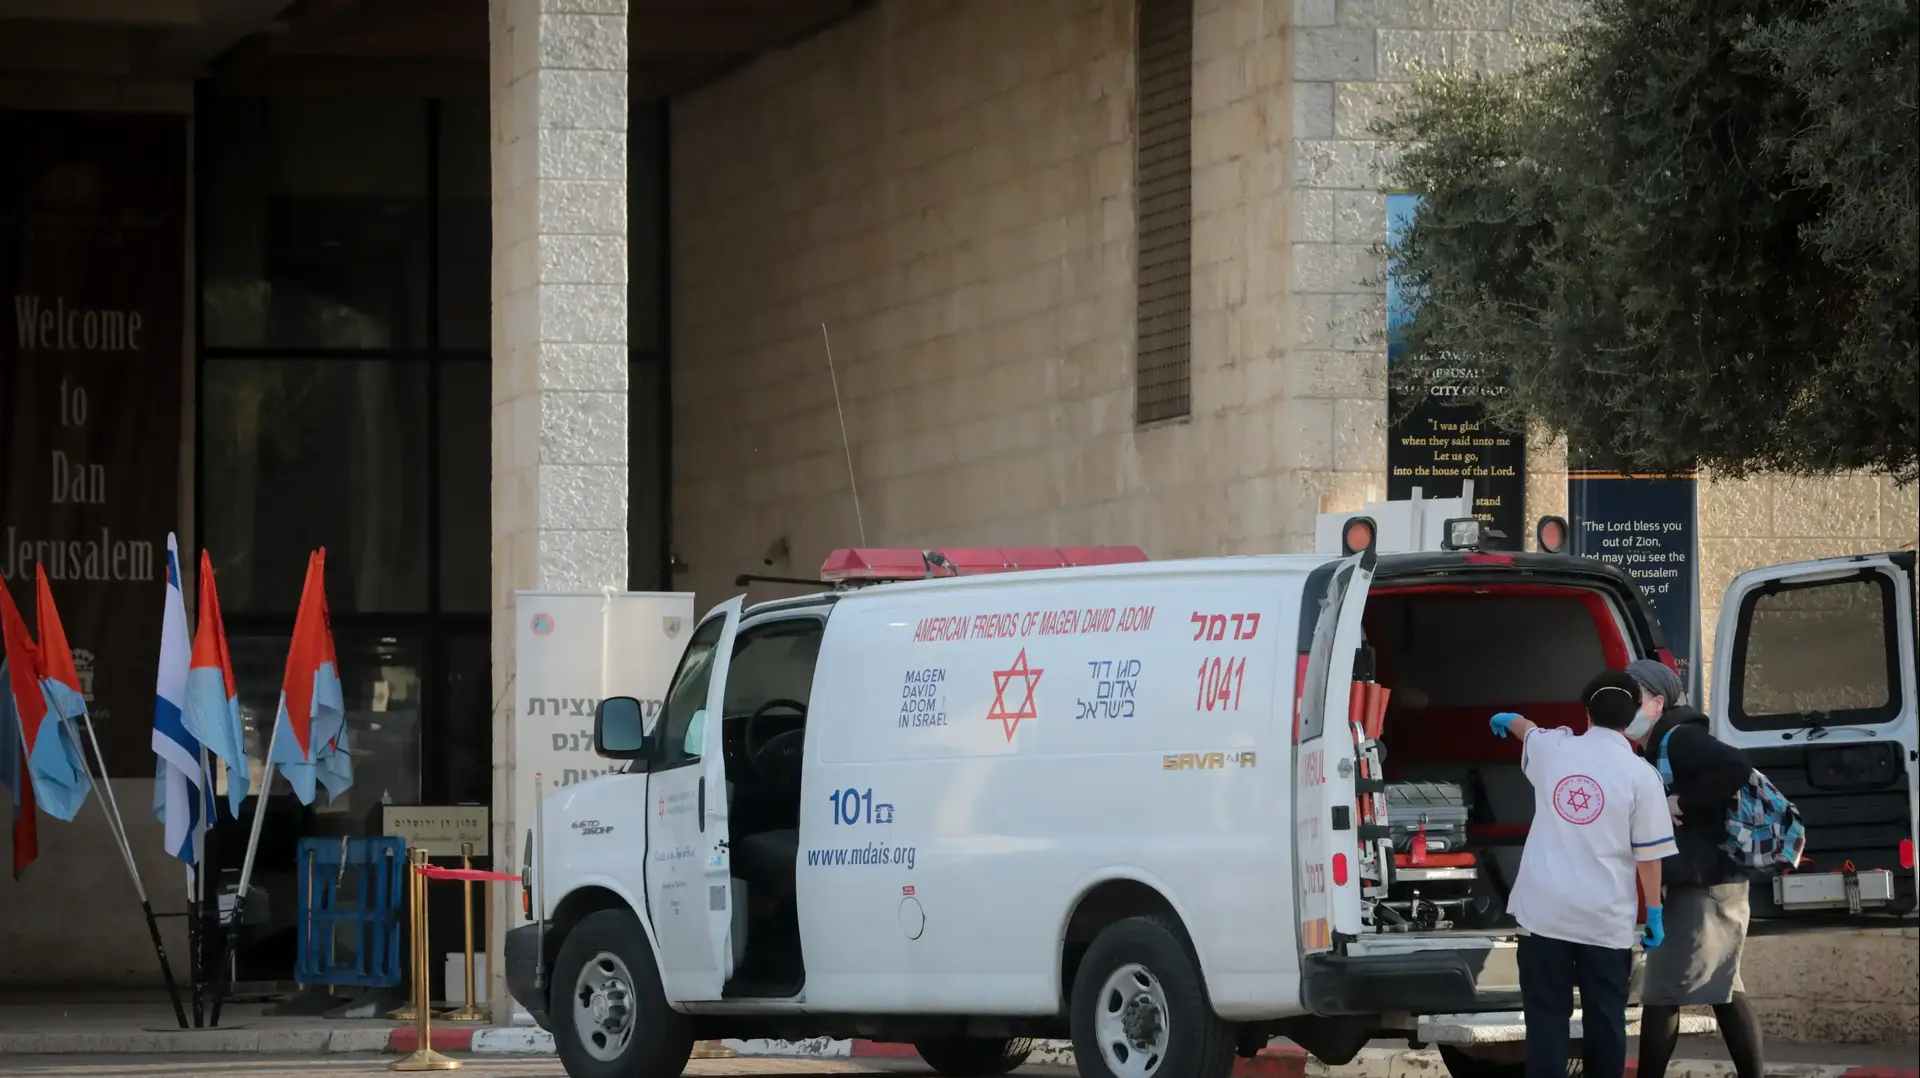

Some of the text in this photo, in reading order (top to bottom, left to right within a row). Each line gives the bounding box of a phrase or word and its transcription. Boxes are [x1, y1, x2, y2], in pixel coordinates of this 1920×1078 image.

[15, 296, 143, 350] Welcome
[1430, 385, 1460, 396] CITY
[60, 377, 88, 426] to
[1440, 423, 1457, 431] was
[1459, 421, 1480, 433] glad
[1402, 436, 1511, 448] when they said unto me
[1434, 451, 1479, 463] Let us go,
[51, 450, 106, 504] Dan
[1393, 466, 1516, 476] into the house of the Lord.
[1475, 496, 1501, 506] stand
[1607, 521, 1631, 532] Lord
[1633, 521, 1660, 532] bless
[1663, 523, 1682, 534] you
[1602, 537, 1661, 548] out of Zion,
[0, 526, 155, 581] Jerusalem
[1602, 555, 1624, 565] may
[1626, 554, 1646, 565] you
[1648, 554, 1666, 563] see
[1668, 552, 1685, 562] the
[1639, 582, 1670, 595] ays of
[913, 605, 1155, 643] AMERICAN FRIENDS OF MAGEN DAVID ADOM
[1191, 611, 1261, 642] כרמל
[904, 668, 947, 684] MAGEN
[1088, 659, 1142, 680] מגן דוד
[902, 683, 937, 699] DAVID
[1096, 680, 1137, 699] אדום
[1196, 656, 1247, 712] 1041
[900, 698, 936, 714] ADOM
[1075, 698, 1136, 720] בישראל
[898, 712, 948, 728] IN ISRAEL
[829, 788, 872, 825] 101
[807, 842, 916, 870] www.mdais.org
